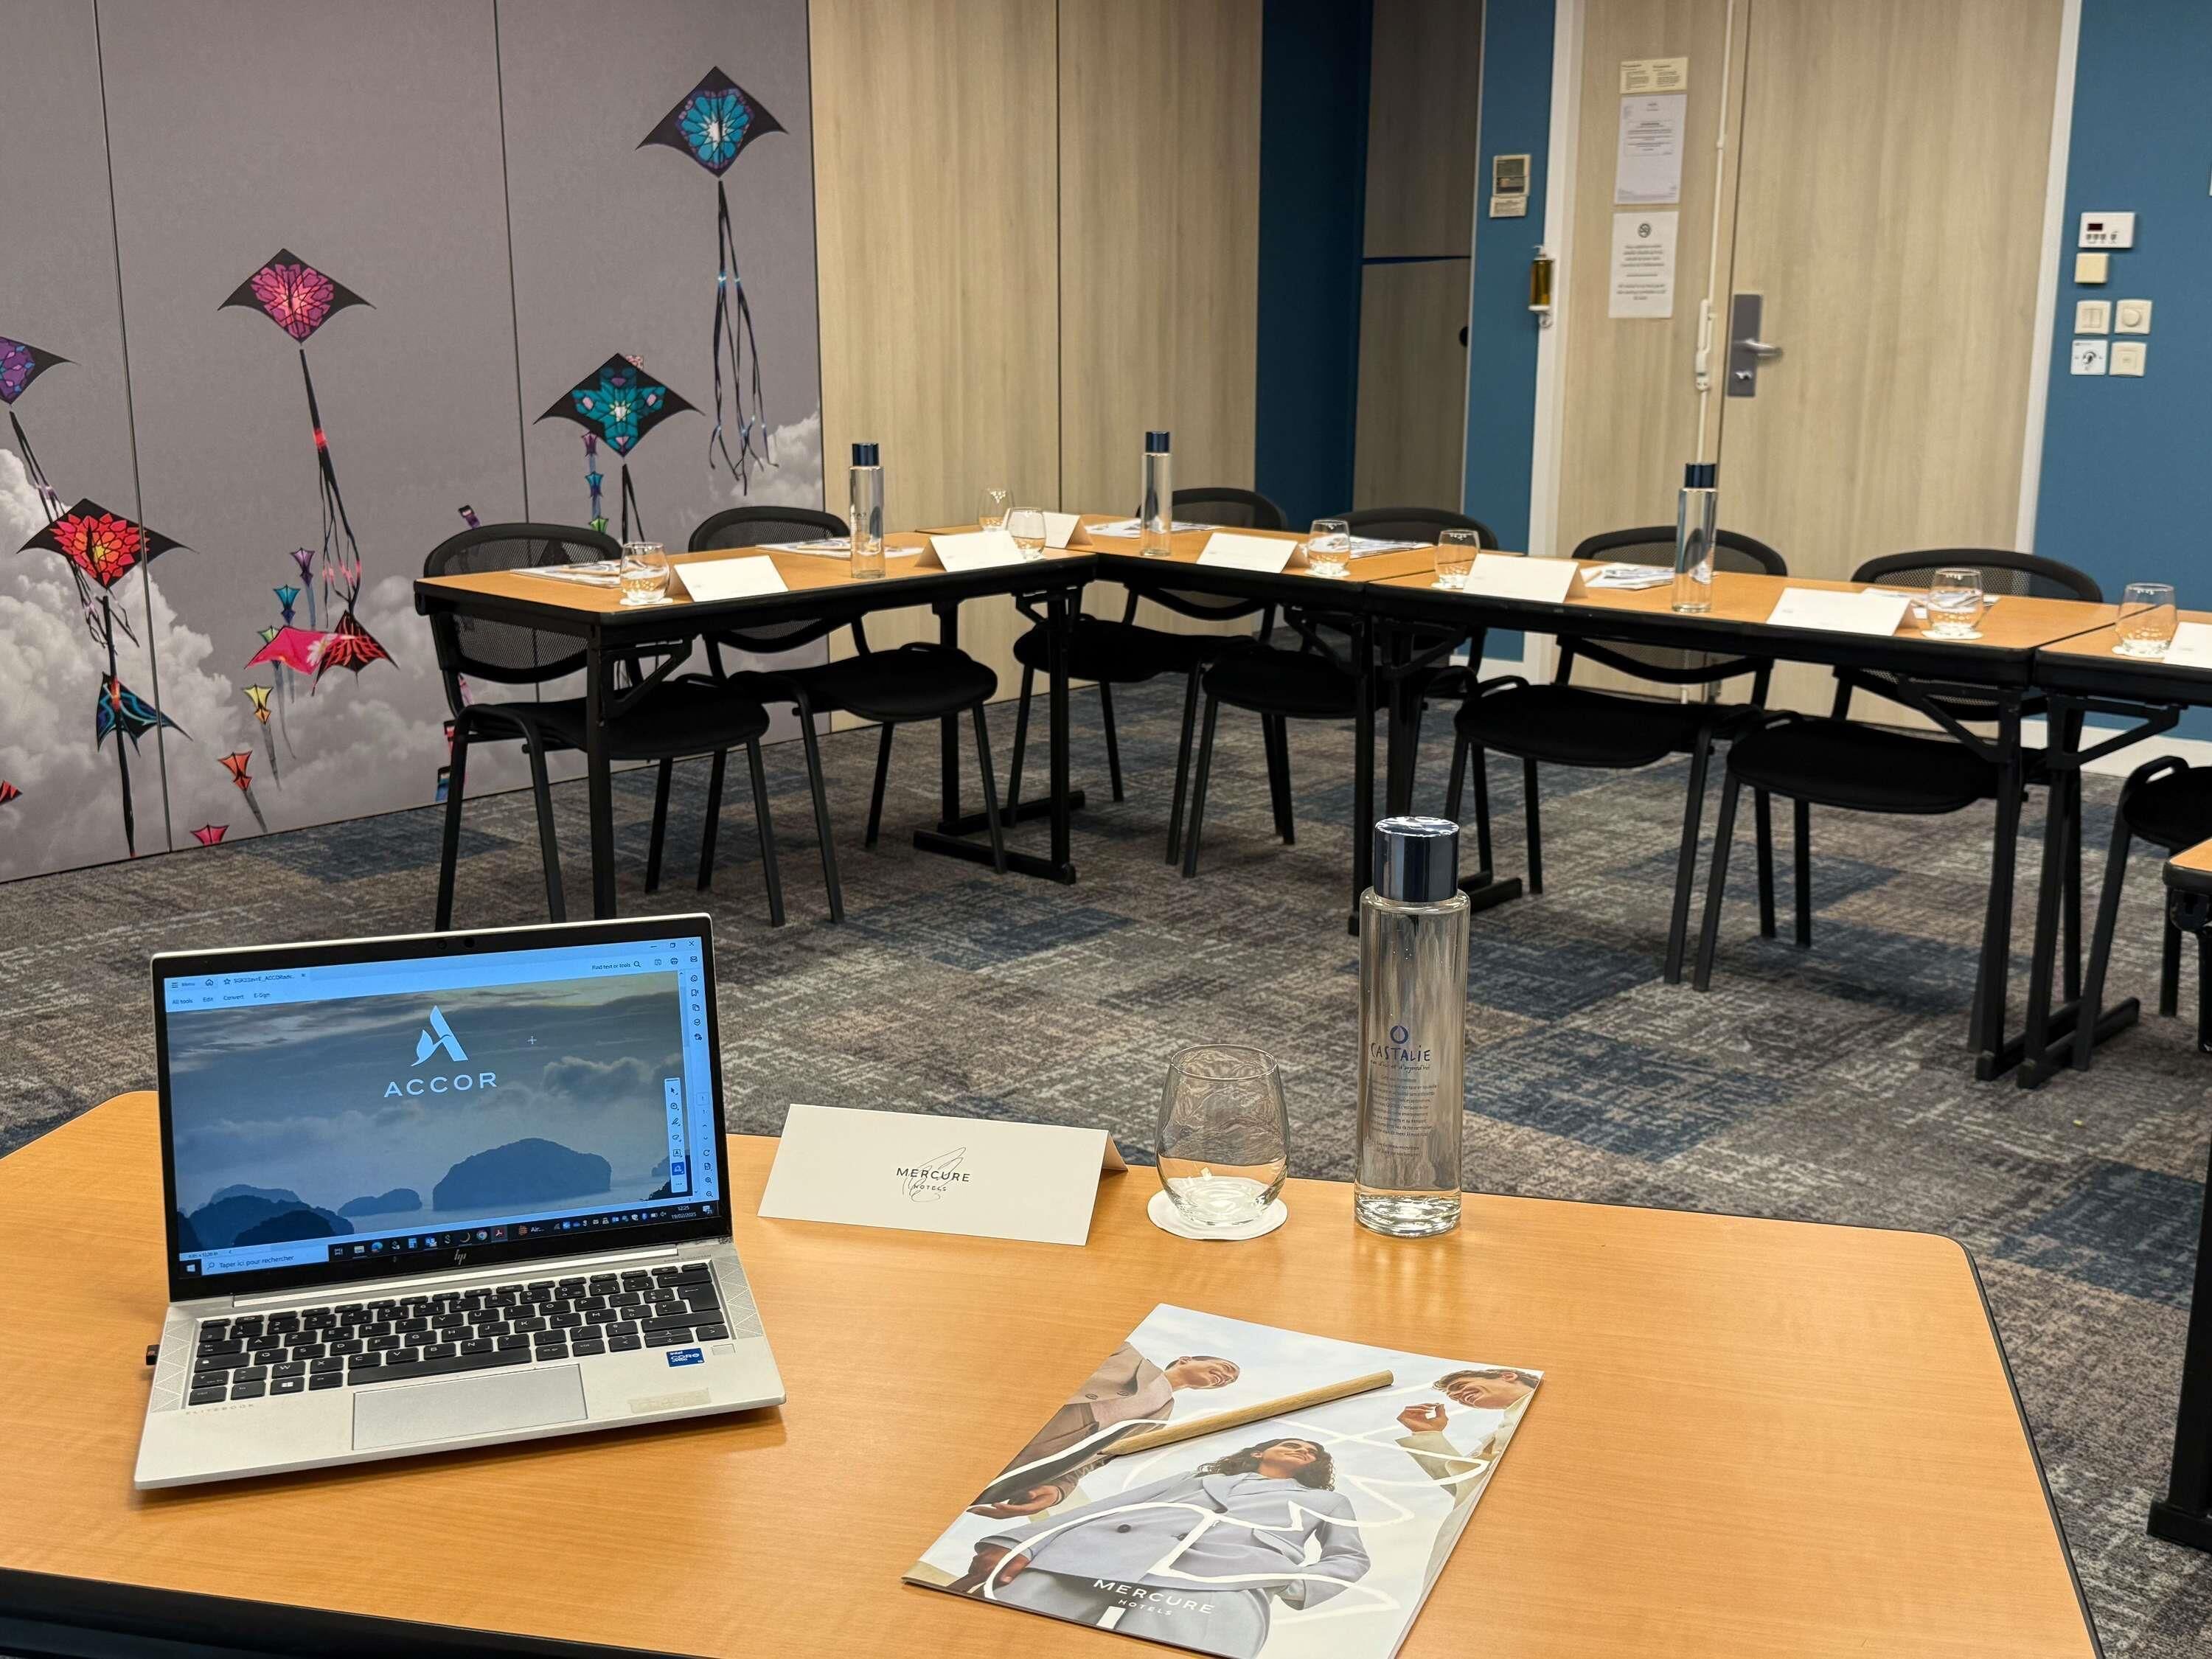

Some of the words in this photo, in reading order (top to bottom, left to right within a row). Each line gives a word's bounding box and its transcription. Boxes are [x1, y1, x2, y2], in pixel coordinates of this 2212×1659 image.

[383, 1072, 497, 1098] ACCOR
[896, 1167, 970, 1182] MERCURE
[262, 1255, 294, 1263] rechercher
[1093, 1579, 1216, 1615] MERCURE
[1118, 1599, 1173, 1616] HOTELS
